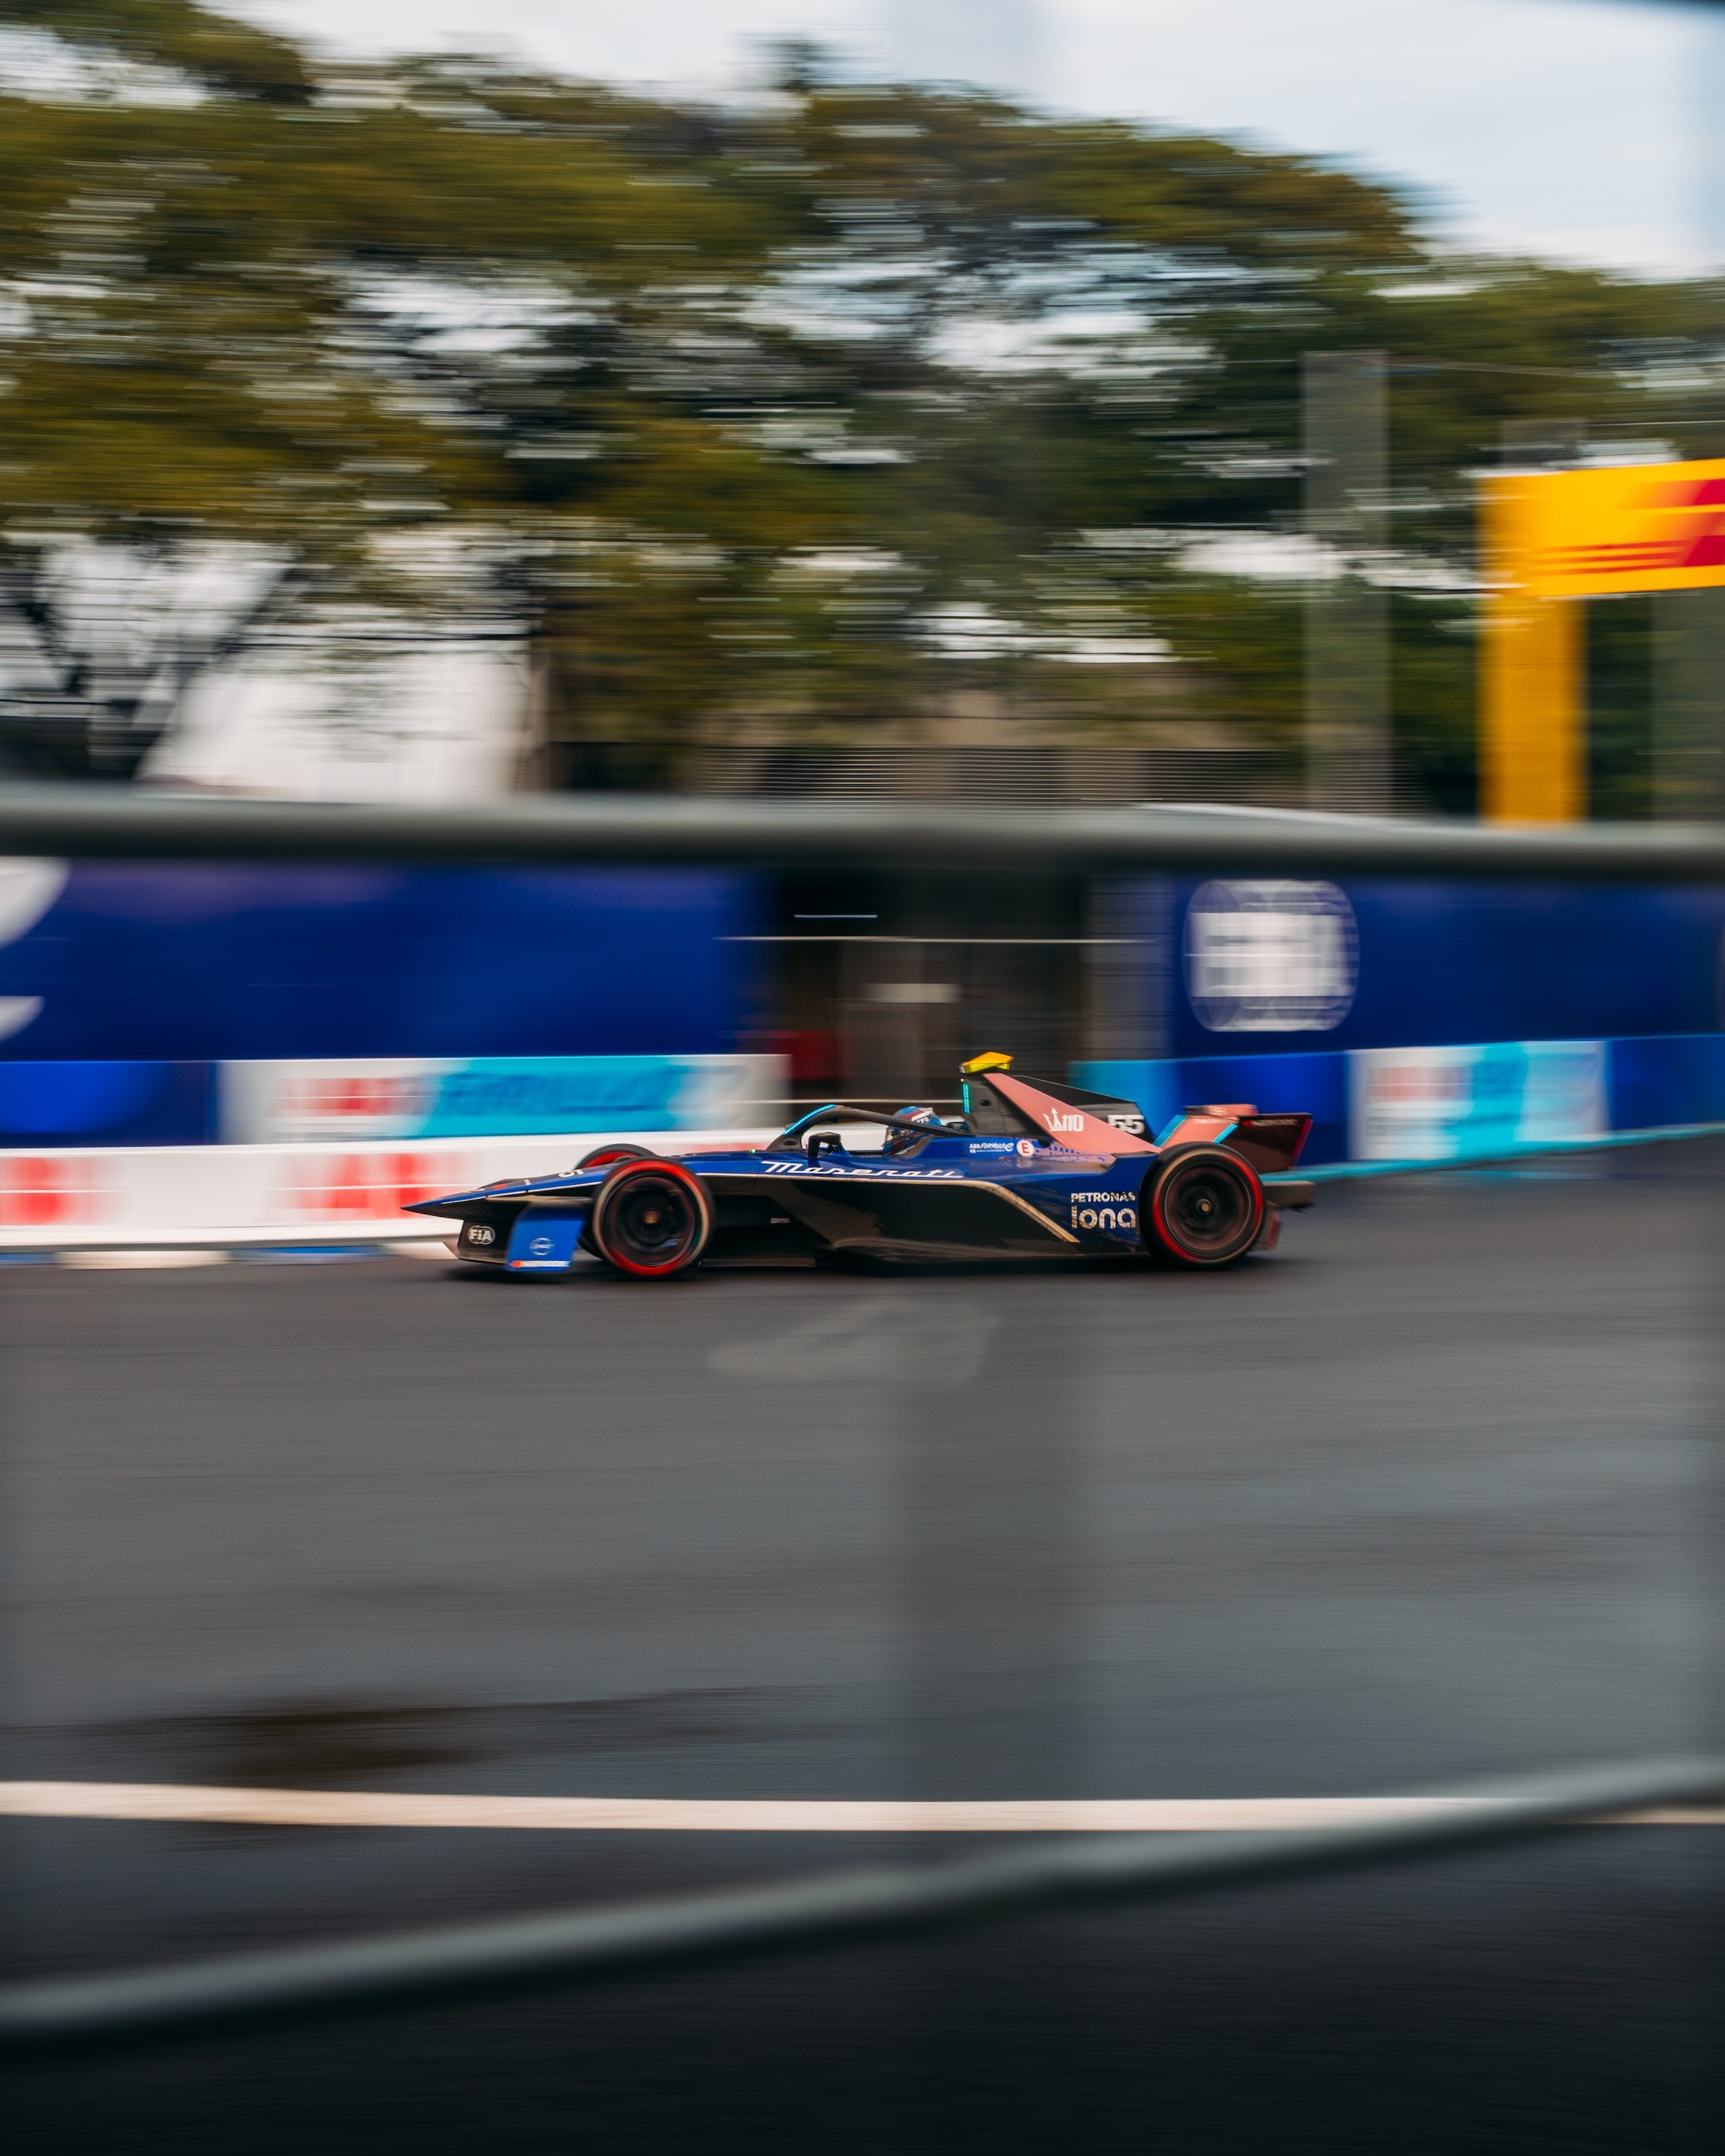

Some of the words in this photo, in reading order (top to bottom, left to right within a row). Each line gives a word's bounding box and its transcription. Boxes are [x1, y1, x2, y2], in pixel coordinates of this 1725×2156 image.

[1062, 1114, 1084, 1132] 110
[1107, 1114, 1145, 1135] 55
[1021, 1143, 1030, 1154] E
[760, 1161, 964, 1178] Maserati
[1071, 1192, 1136, 1202] PETRONAS
